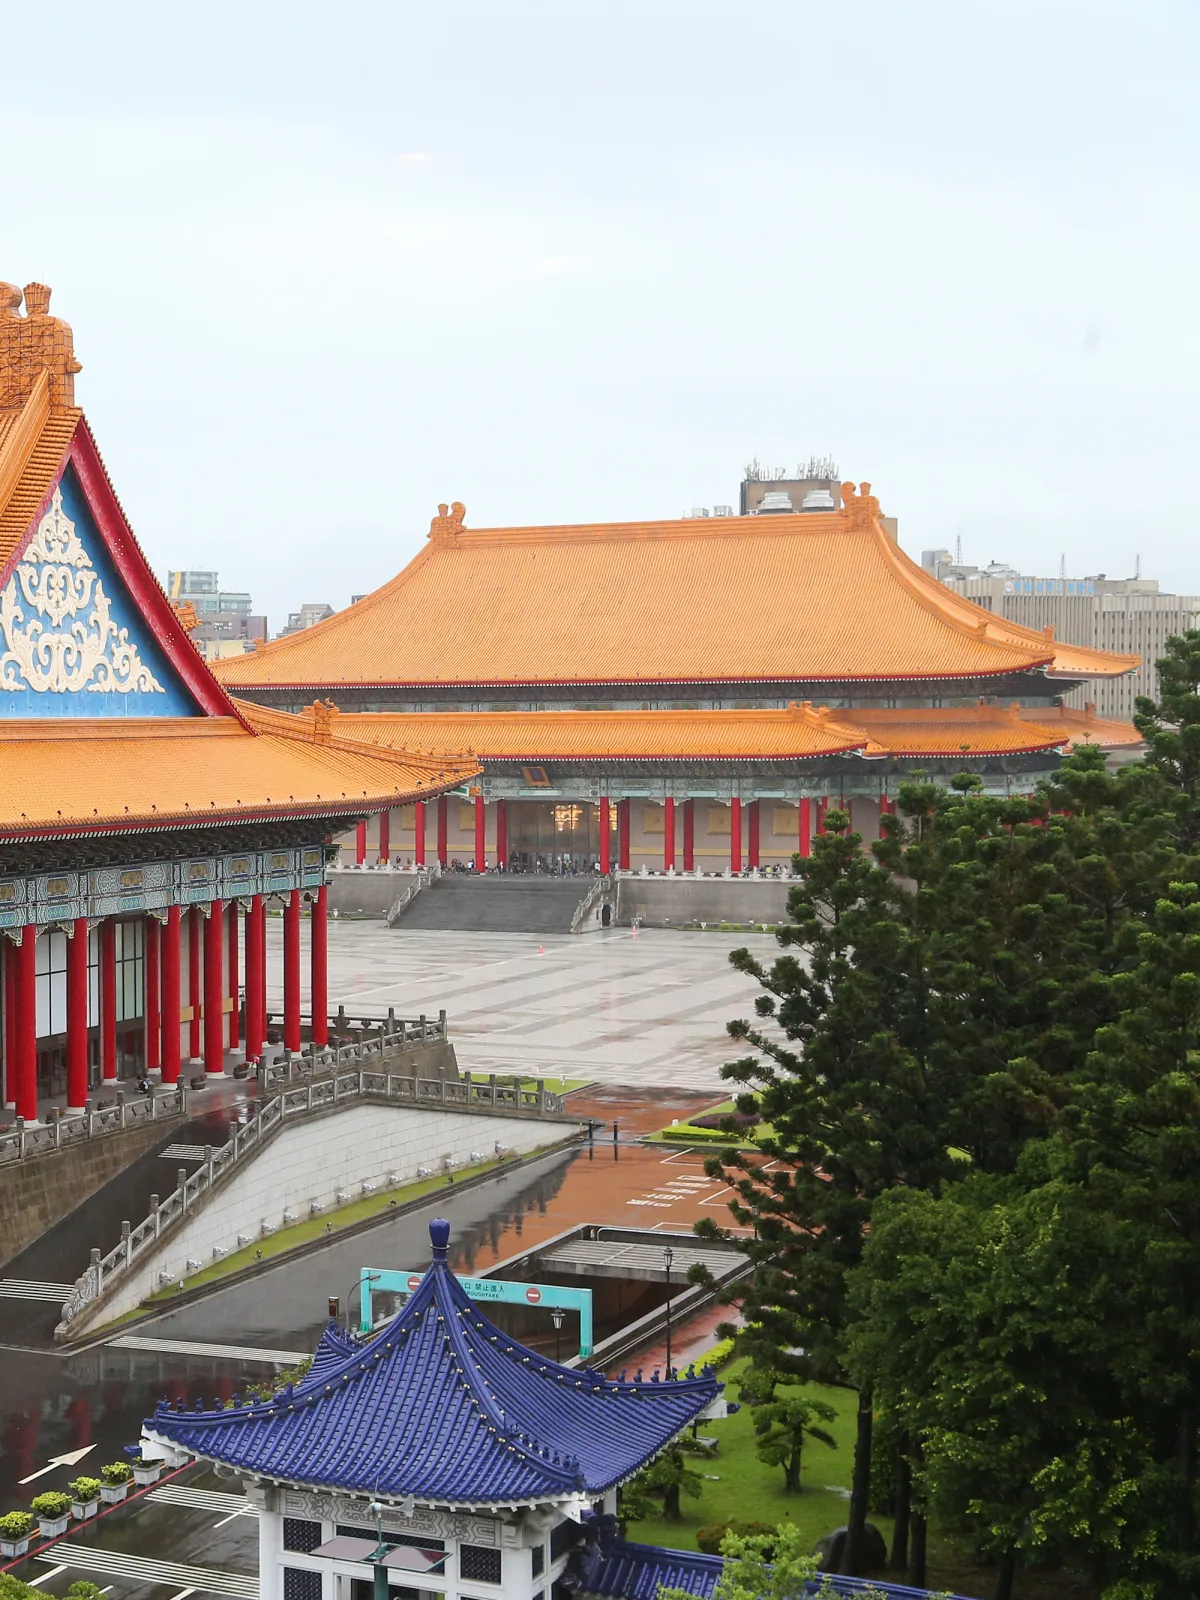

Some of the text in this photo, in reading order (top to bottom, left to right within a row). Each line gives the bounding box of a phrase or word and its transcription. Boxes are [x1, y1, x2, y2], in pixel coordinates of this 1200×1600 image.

[475, 1283, 505, 1293] 禁止進入
[466, 1290, 500, 1299] ROUGHFARE
